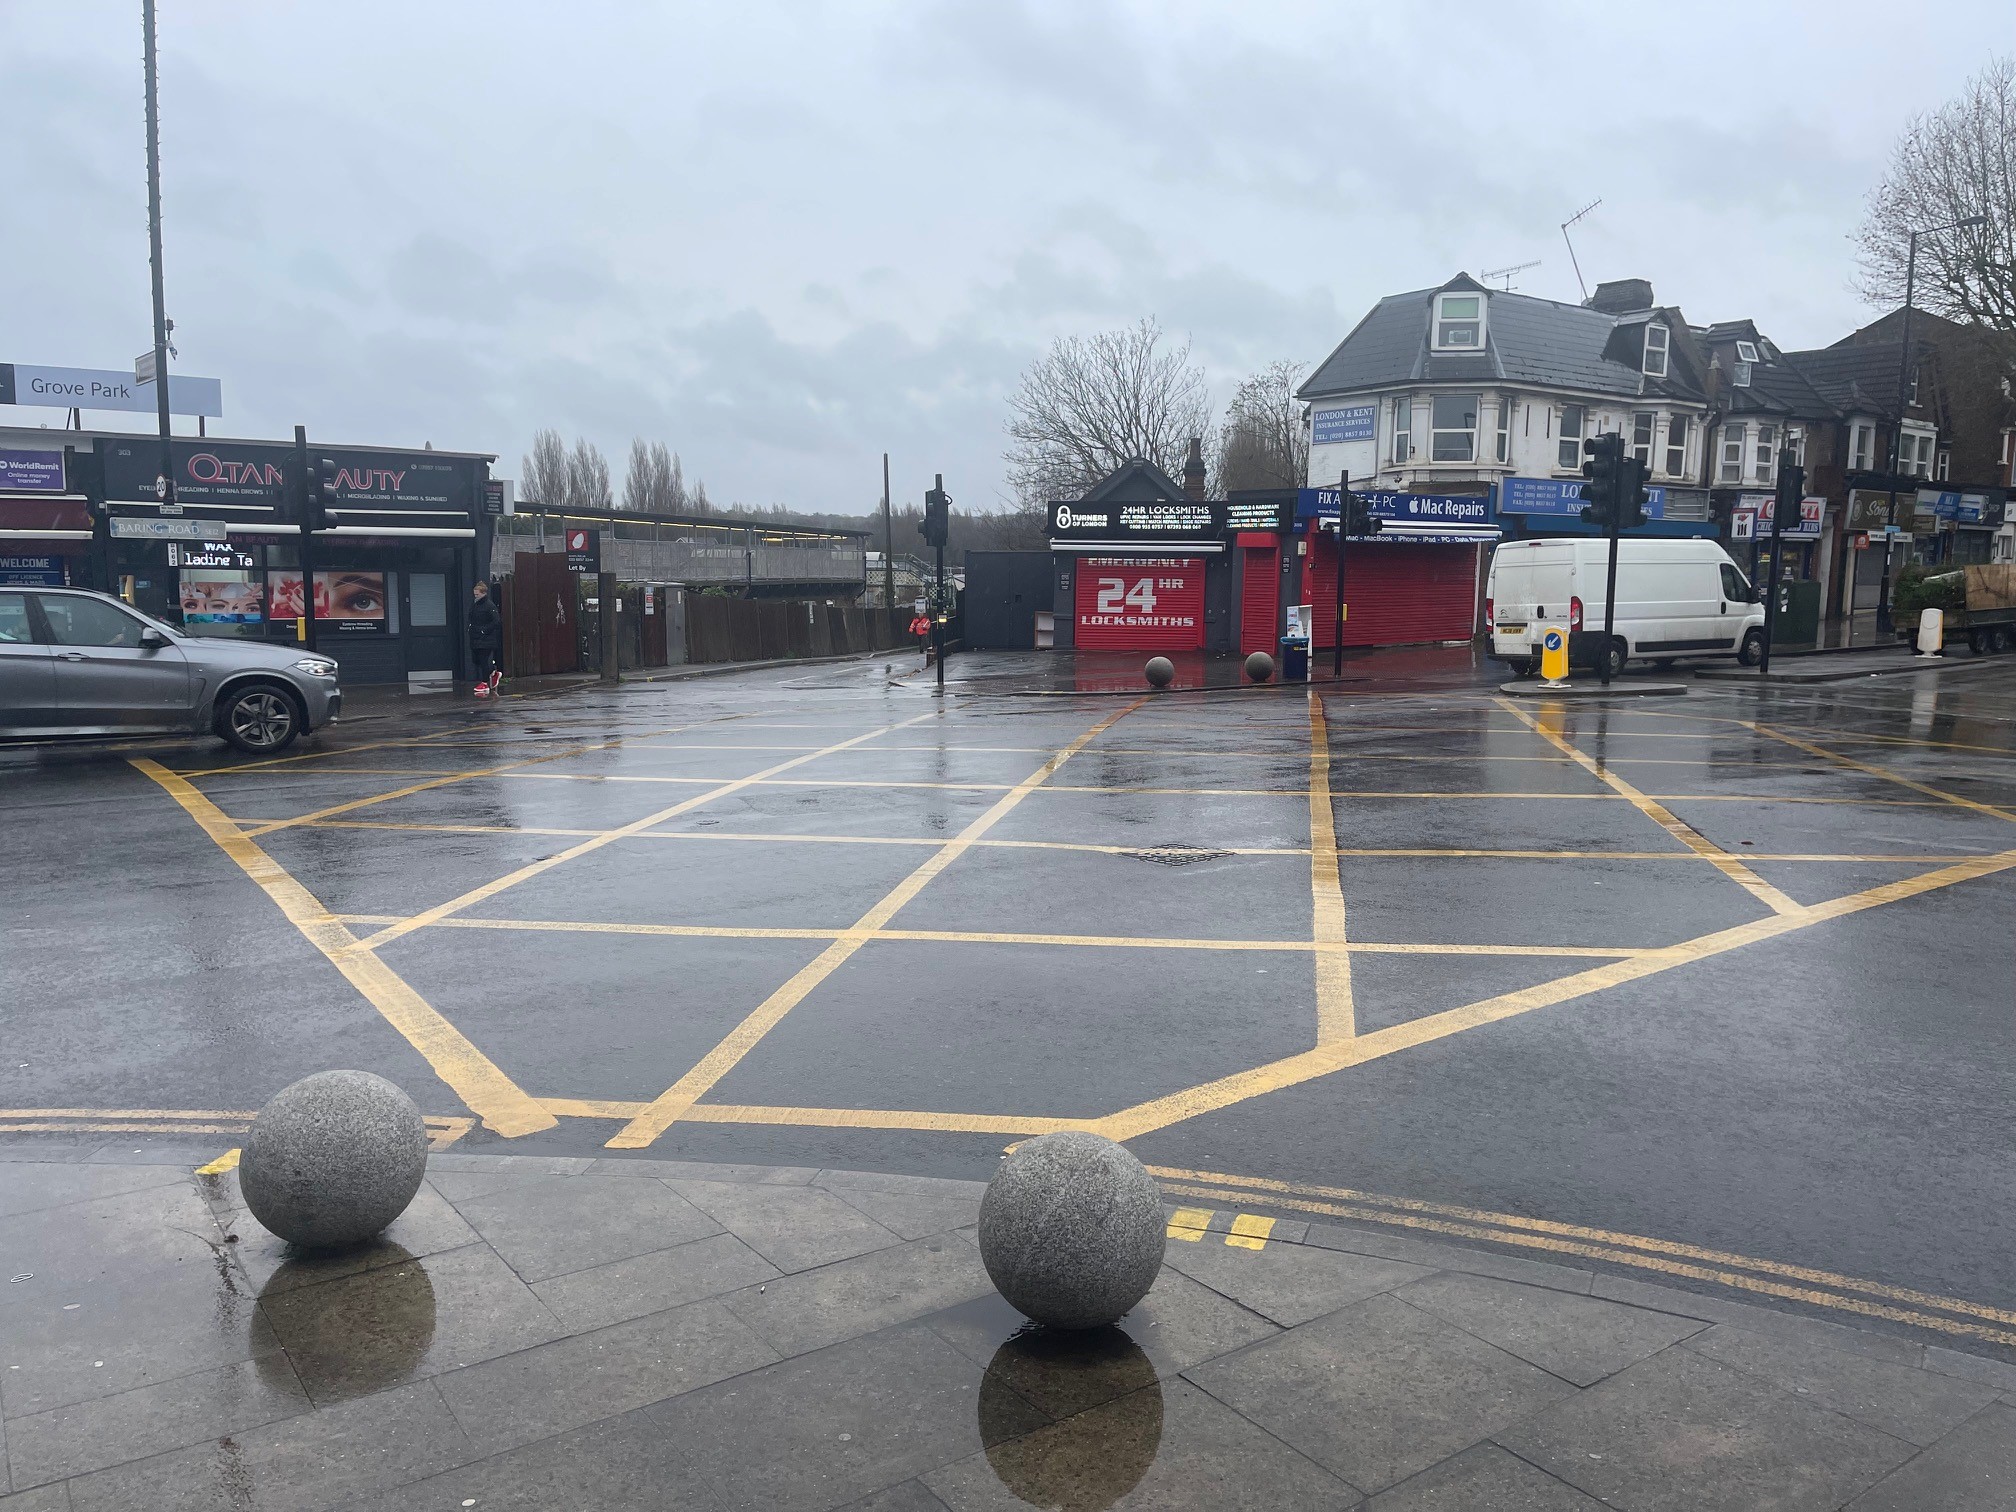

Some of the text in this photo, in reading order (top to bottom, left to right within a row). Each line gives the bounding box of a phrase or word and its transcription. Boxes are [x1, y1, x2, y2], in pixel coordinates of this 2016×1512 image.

[31, 378, 131, 399] Grove Park
[1315, 410, 1346, 421] LONDON
[1353, 407, 1374, 417] KENT
[1316, 418, 1371, 429] INSURANCE SERVICES
[1329, 432, 1344, 440] (020)
[9, 461, 60, 471] WorldRemit
[187, 453, 283, 486] QTAN
[158, 481, 165, 492] 20
[1318, 491, 1332, 505] FIX
[1382, 495, 1397, 508] PC
[1122, 506, 1210, 515] 24HR LOCKSMITHS
[1420, 498, 1485, 519] Mac Repairs
[118, 523, 163, 534] BARING
[168, 525, 200, 535] ROAD
[1397, 535, 1418, 543] iPhone
[0, 558, 50, 568] WELCOME
[184, 553, 231, 566] lading
[578, 564, 587, 572] By
[1097, 578, 1157, 613] 24
[1158, 578, 1184, 589] HR
[1081, 615, 1194, 627] LOCKSMITHS
